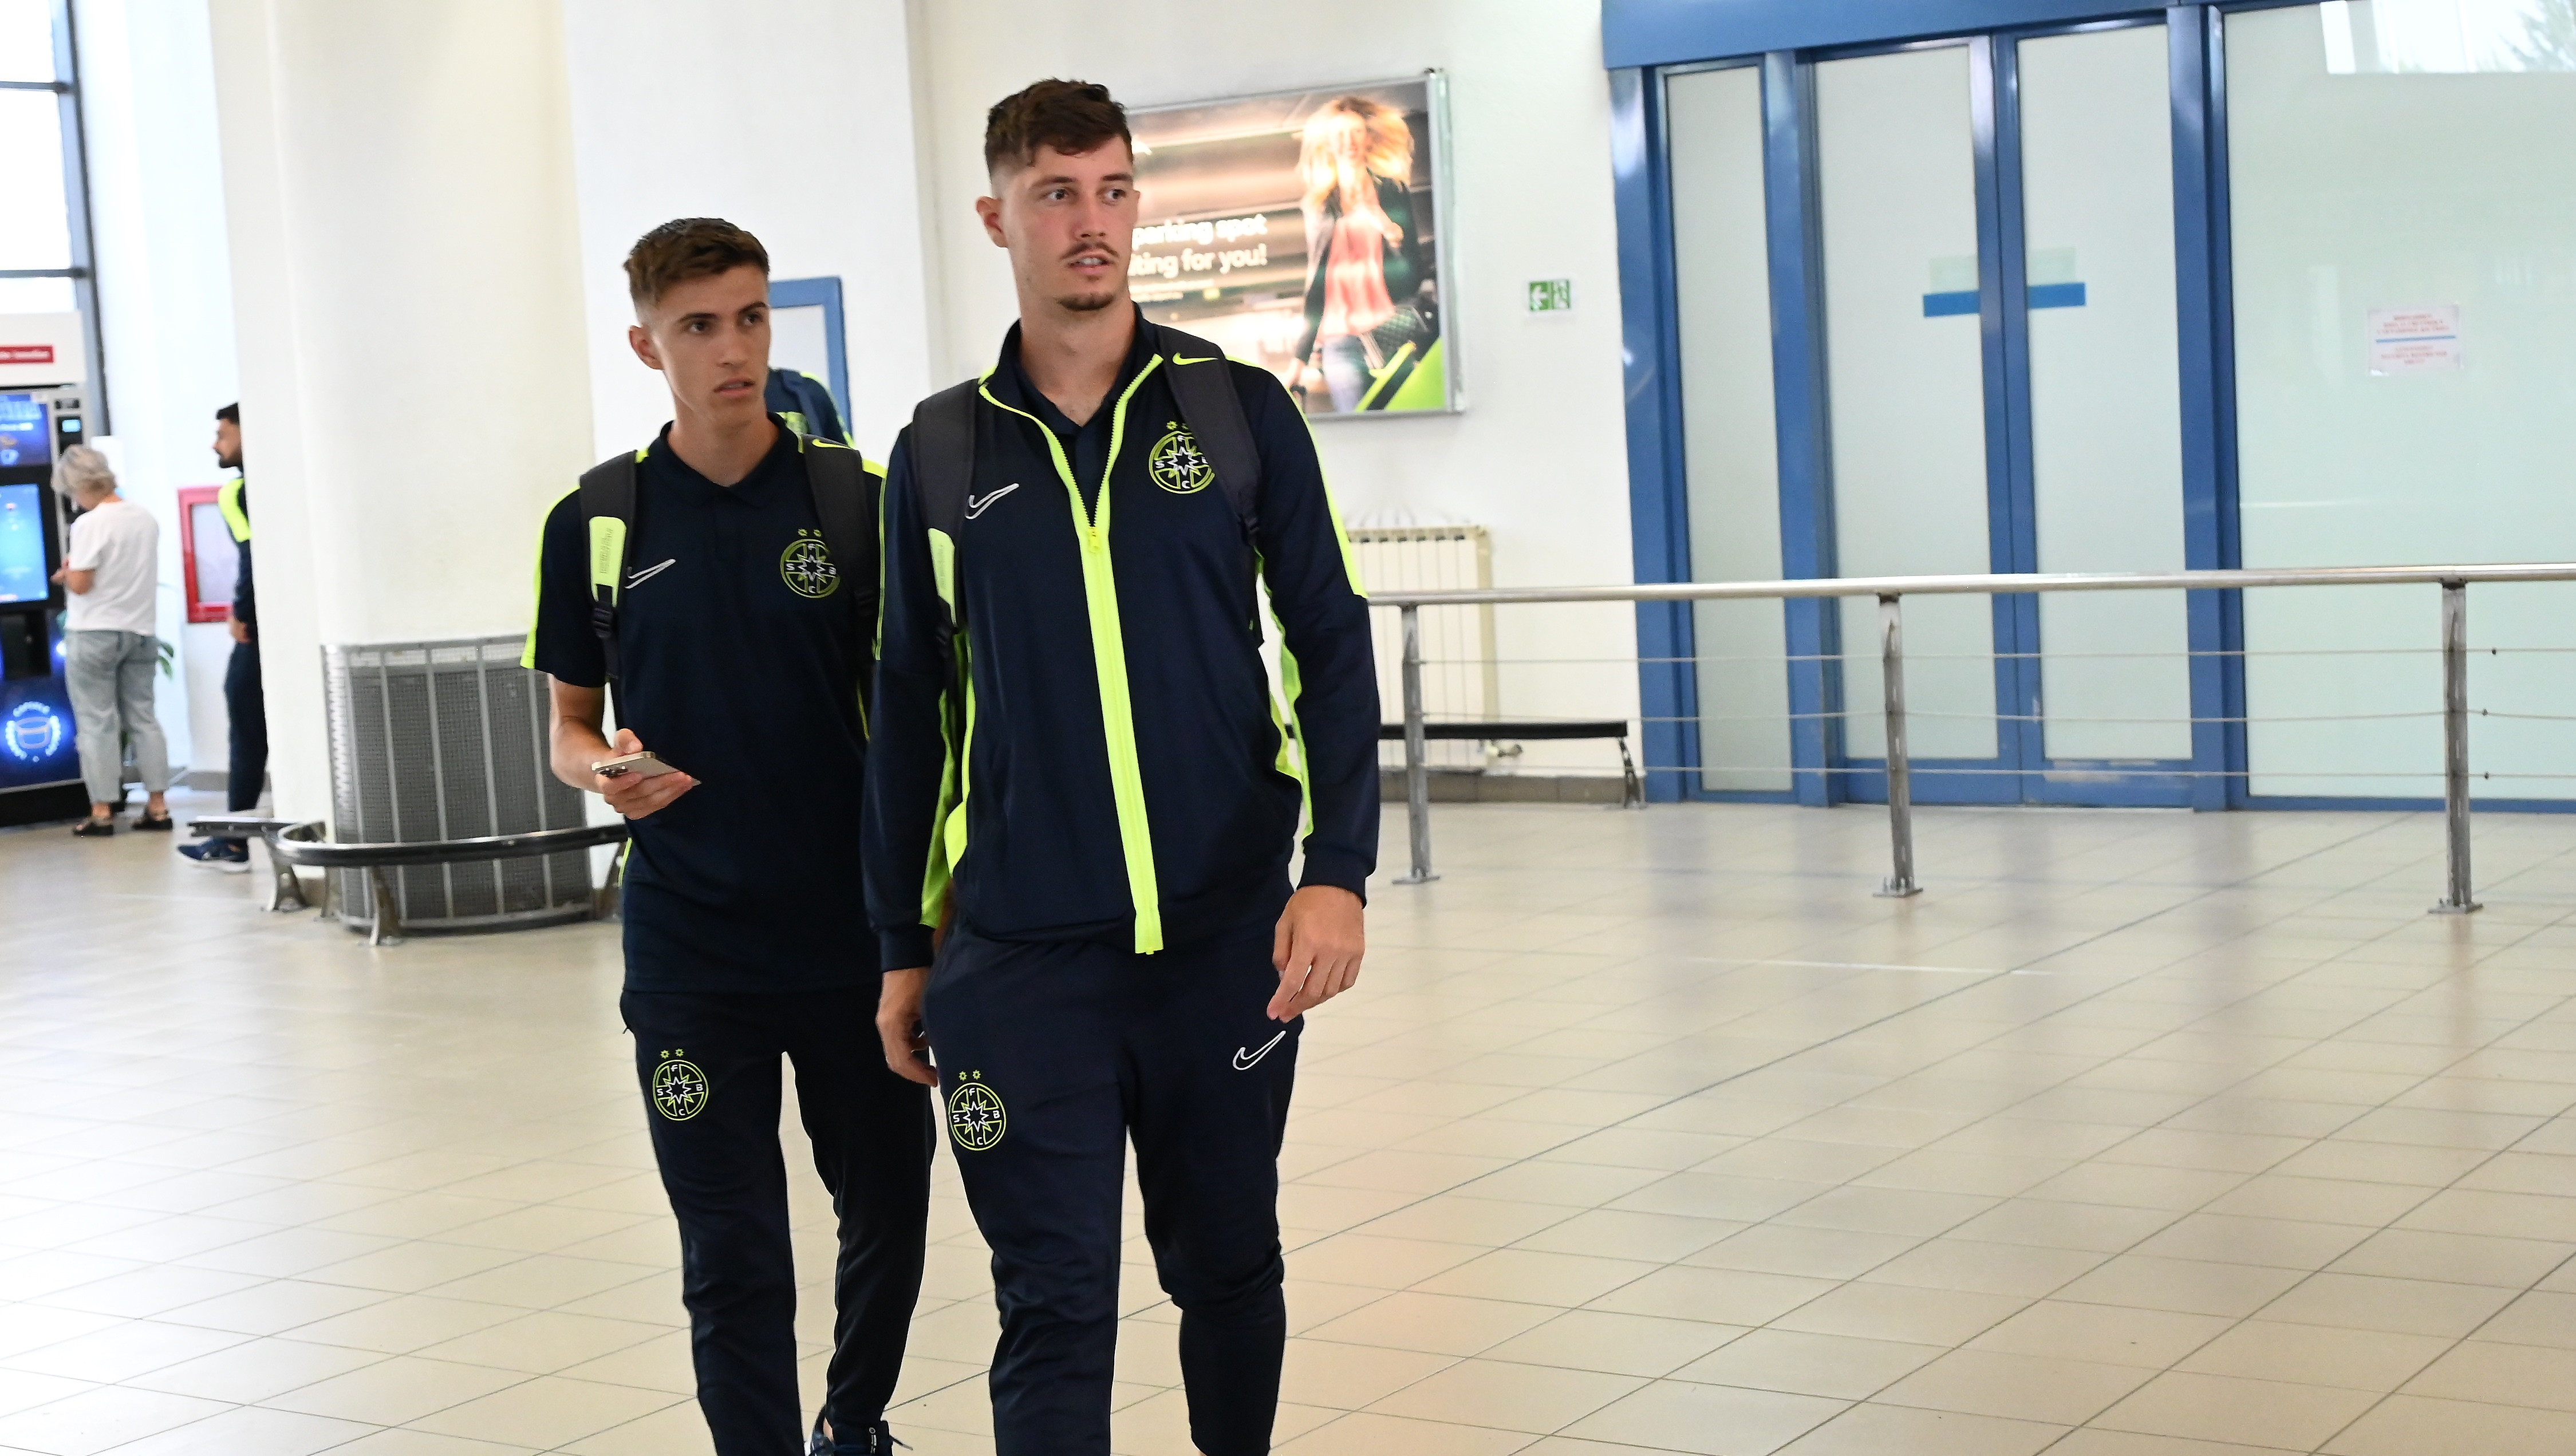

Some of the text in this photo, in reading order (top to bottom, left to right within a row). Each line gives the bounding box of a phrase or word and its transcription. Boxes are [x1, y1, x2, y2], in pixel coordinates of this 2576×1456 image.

[1132, 214, 1267, 251] parking spot
[1181, 248, 1215, 271] for
[1218, 243, 1267, 274] you!
[969, 1088, 976, 1096] F
[953, 1110, 1000, 1123] S B
[976, 1137, 984, 1145] C
